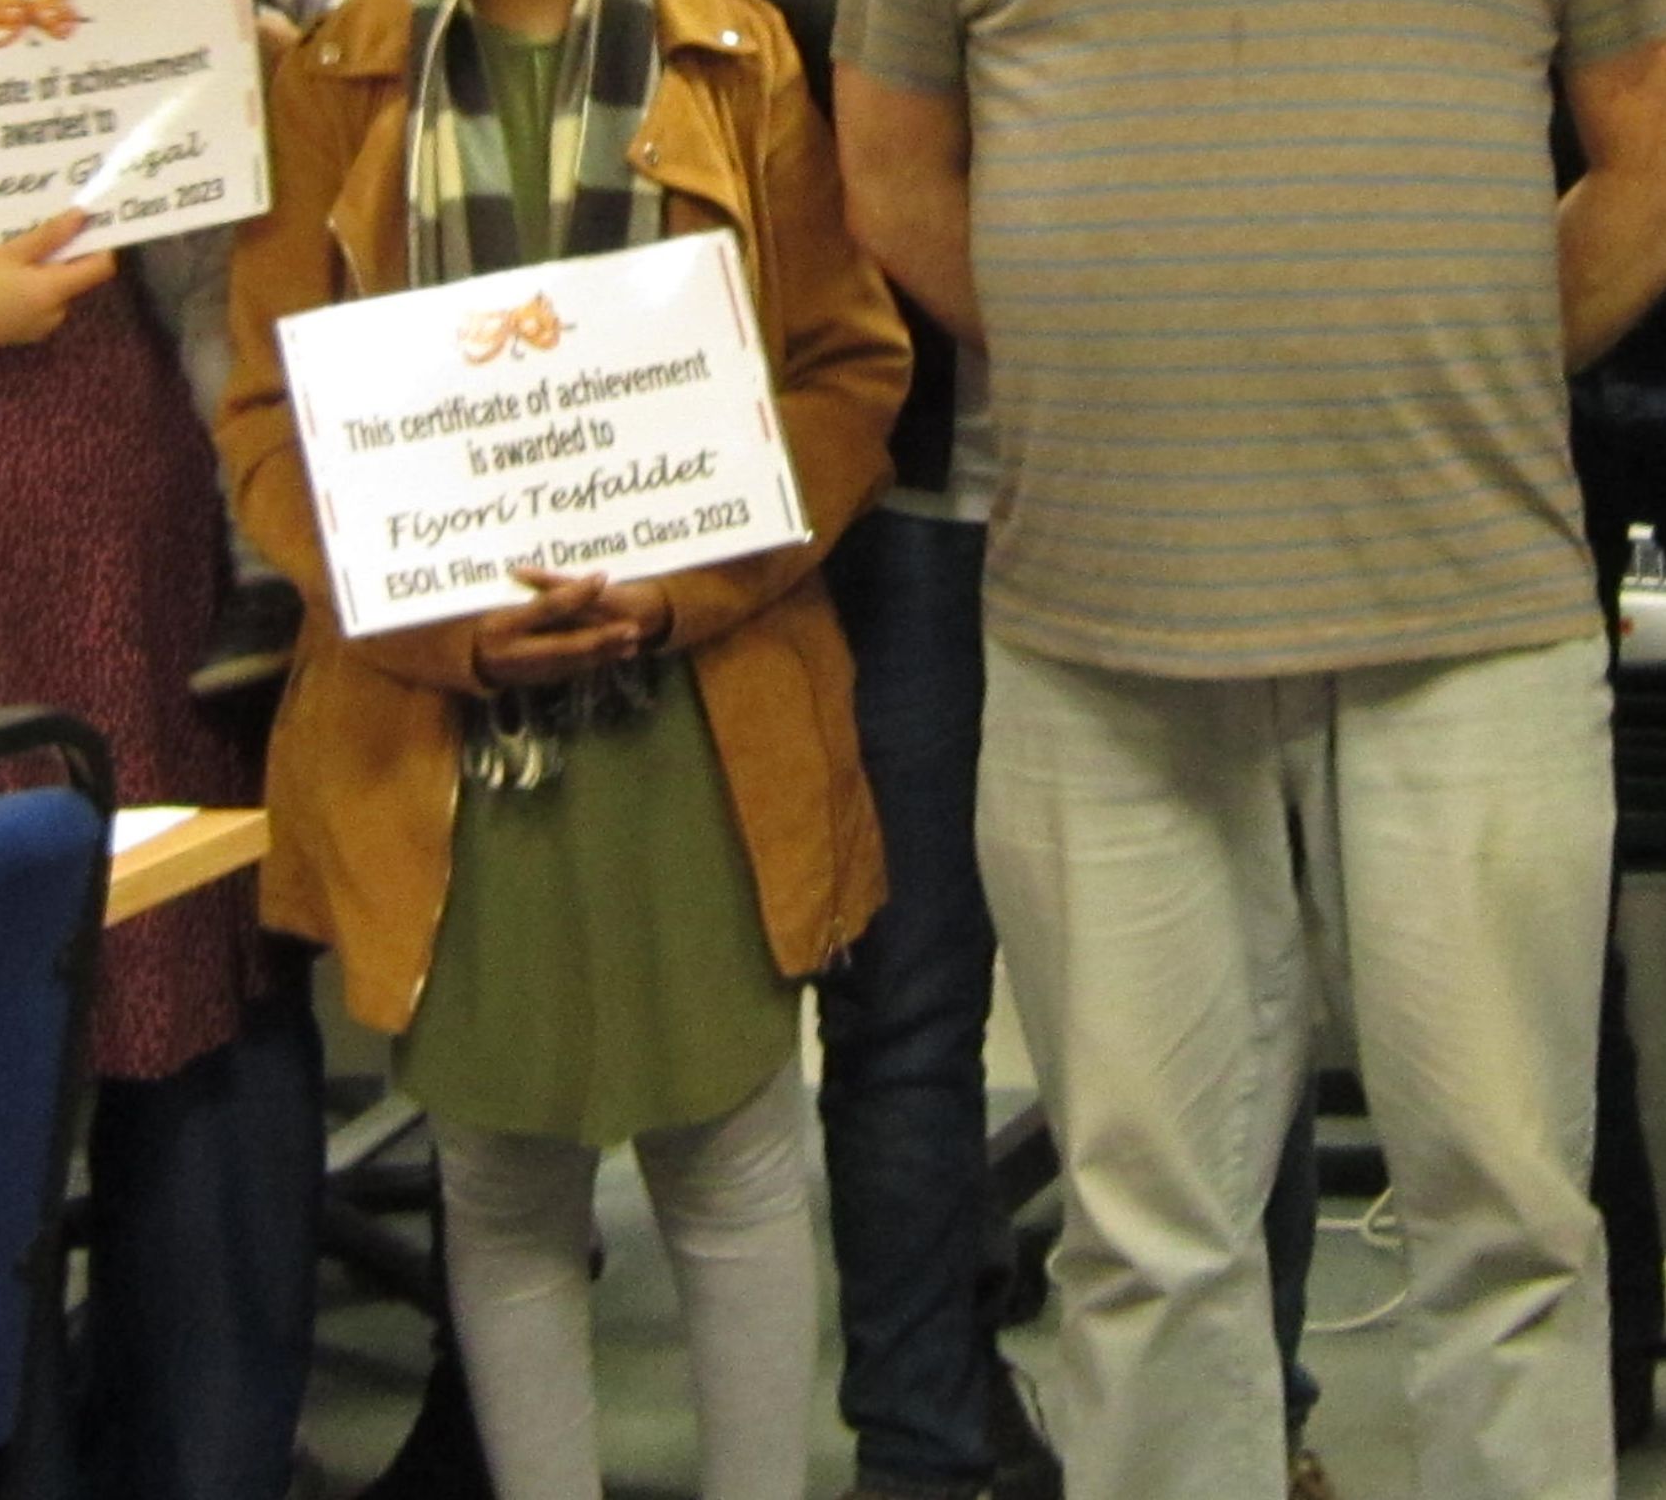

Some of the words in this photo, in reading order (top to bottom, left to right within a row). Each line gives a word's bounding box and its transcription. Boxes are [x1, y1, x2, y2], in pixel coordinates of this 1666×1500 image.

[39, 67, 64, 102] of
[67, 45, 212, 95] achievement
[0, 114, 91, 149] awarded
[94, 107, 119, 134] to
[118, 197, 171, 223] Class
[175, 177, 226, 210] 2023
[344, 417, 395, 455] This
[400, 390, 520, 442] certificate
[527, 379, 552, 415] of
[557, 349, 712, 410] achievement
[465, 438, 489, 477] is
[493, 422, 587, 469] awarded
[590, 416, 616, 452] to
[385, 495, 519, 551] Fiyori
[525, 448, 721, 516] Tesfaldet
[383, 566, 445, 601] ESOL
[448, 550, 499, 587] Film
[504, 543, 546, 578] and
[550, 528, 629, 568] Drama
[632, 512, 691, 551] Class
[694, 498, 753, 536] 2023
